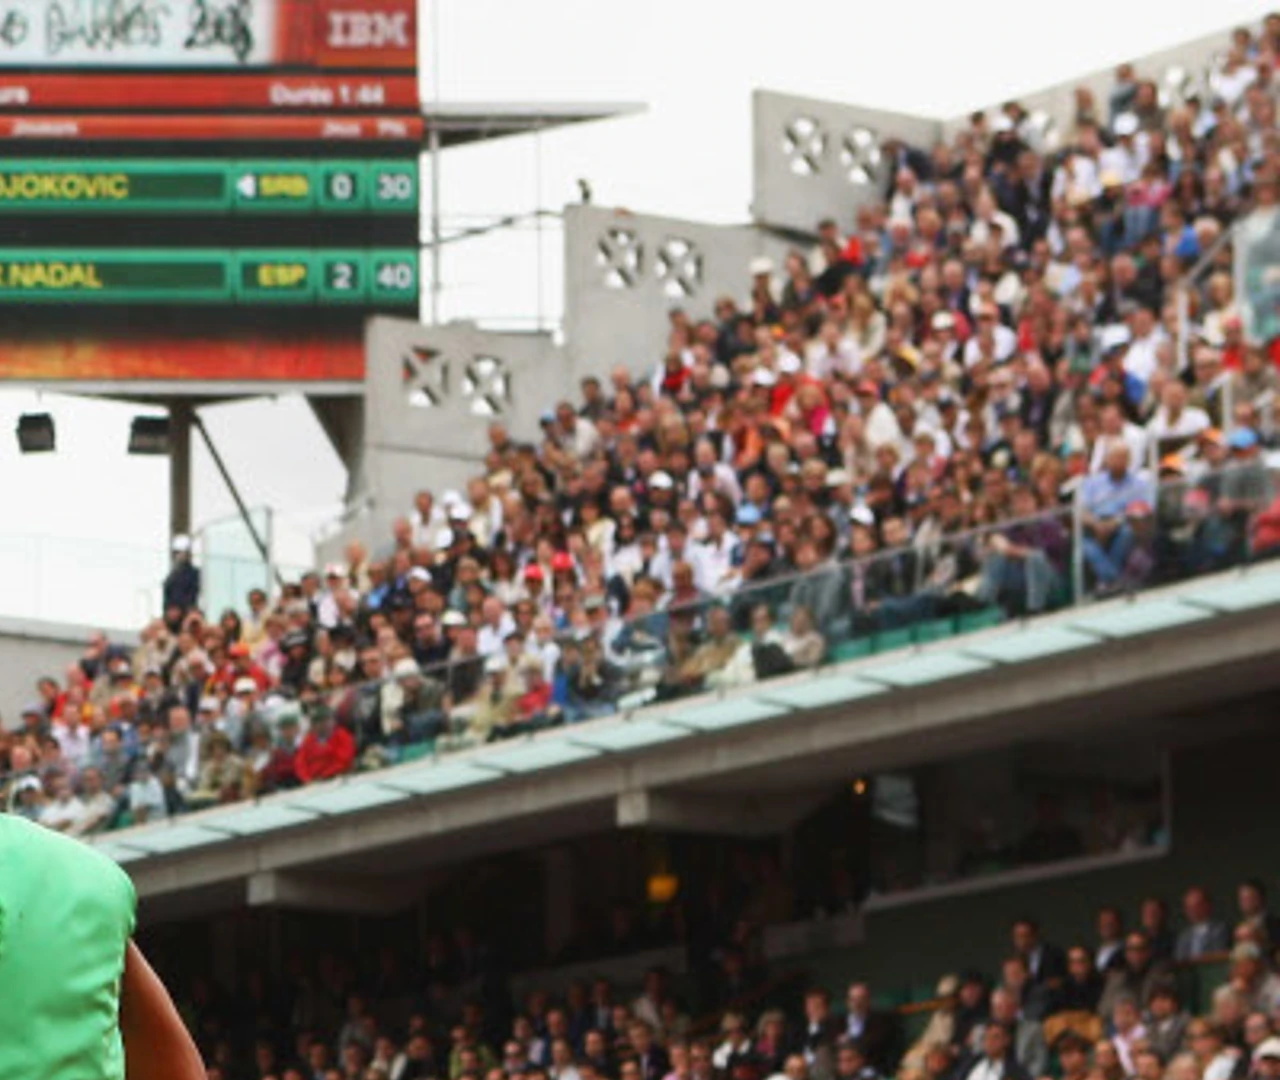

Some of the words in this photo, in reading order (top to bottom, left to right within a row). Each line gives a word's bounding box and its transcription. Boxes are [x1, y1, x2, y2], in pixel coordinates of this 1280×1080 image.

[328, 10, 408, 46] IBM
[331, 173, 353, 199] 0
[377, 173, 413, 199] 30
[257, 263, 307, 288] ESP
[331, 262, 352, 289] 2
[376, 263, 413, 288] 40
